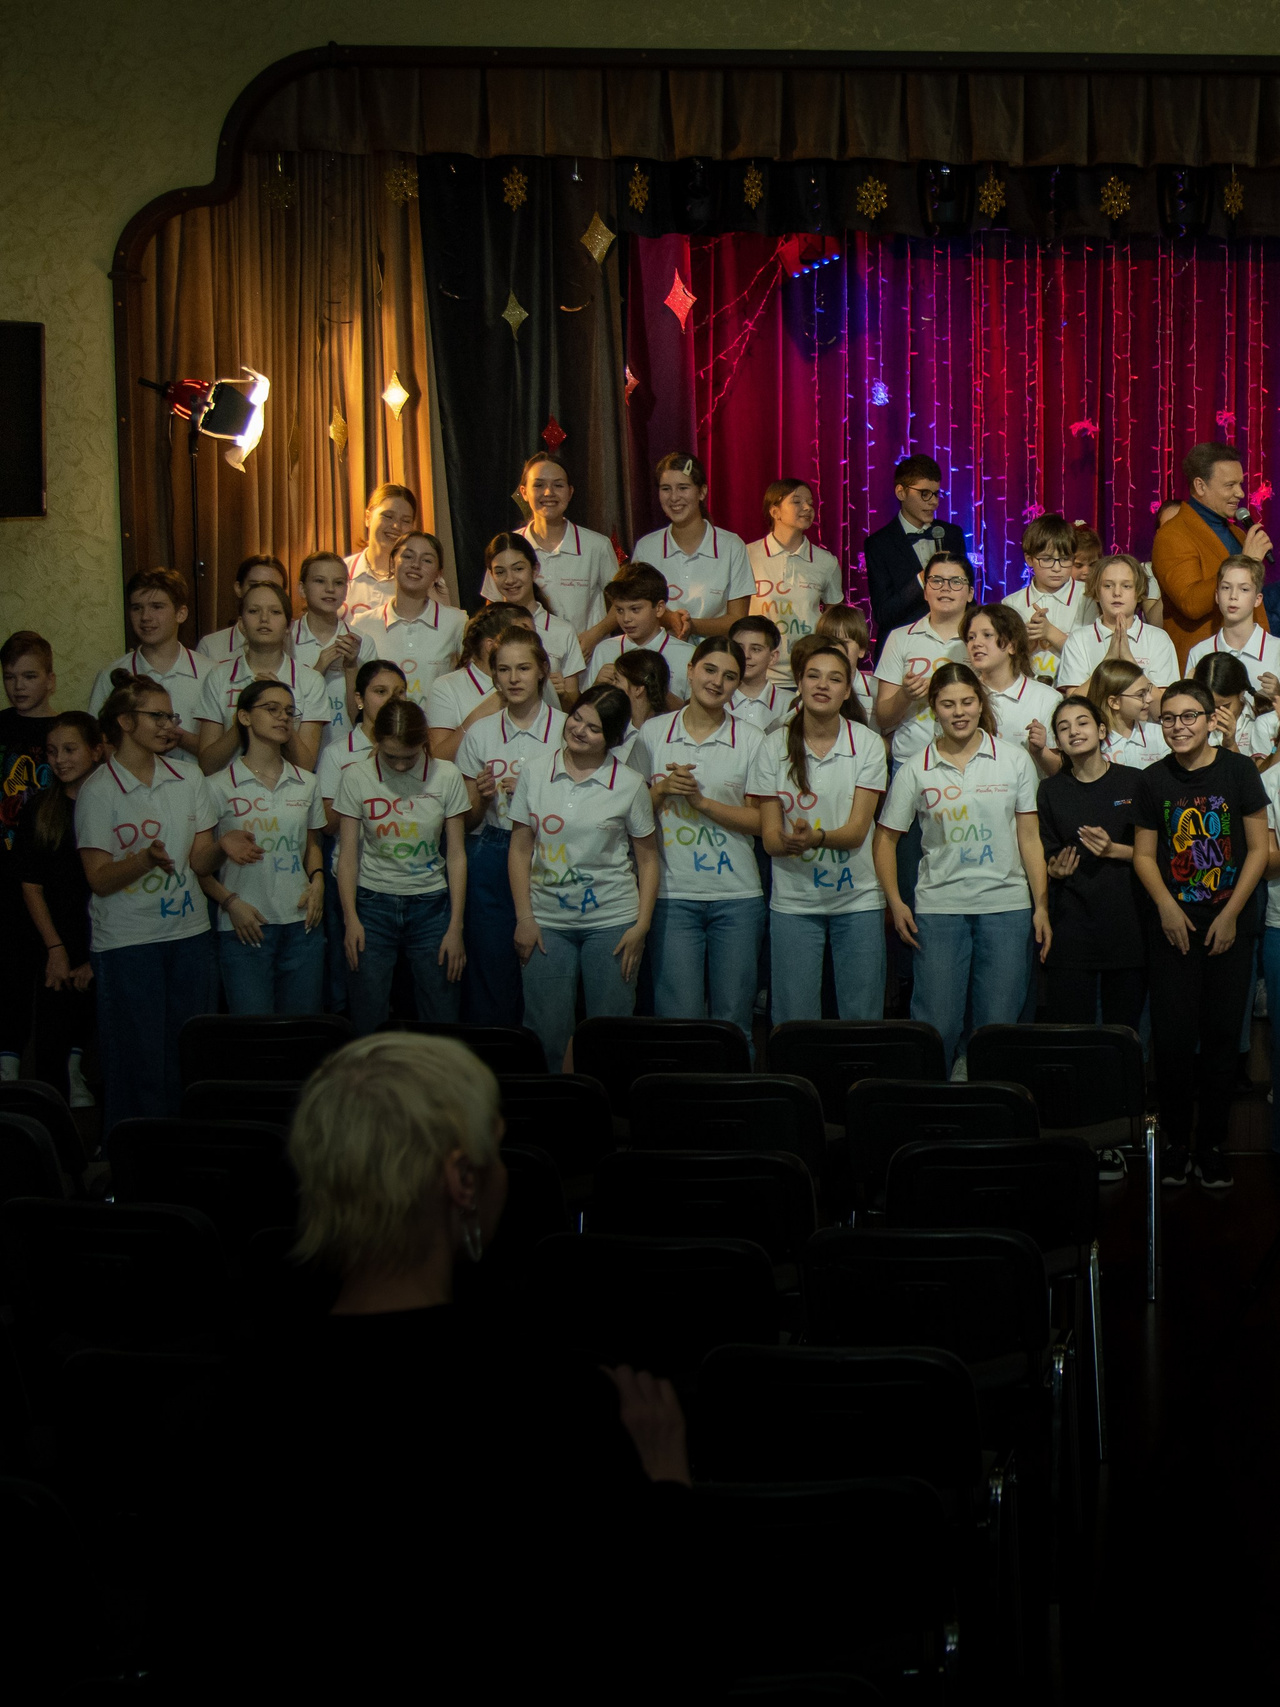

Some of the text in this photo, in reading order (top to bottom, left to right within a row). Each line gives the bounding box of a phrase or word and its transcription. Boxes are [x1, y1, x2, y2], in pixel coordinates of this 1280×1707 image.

[693, 851, 733, 874] КА
[960, 845, 994, 865] КА
[814, 867, 854, 891] КА
[161, 890, 195, 918] КА
